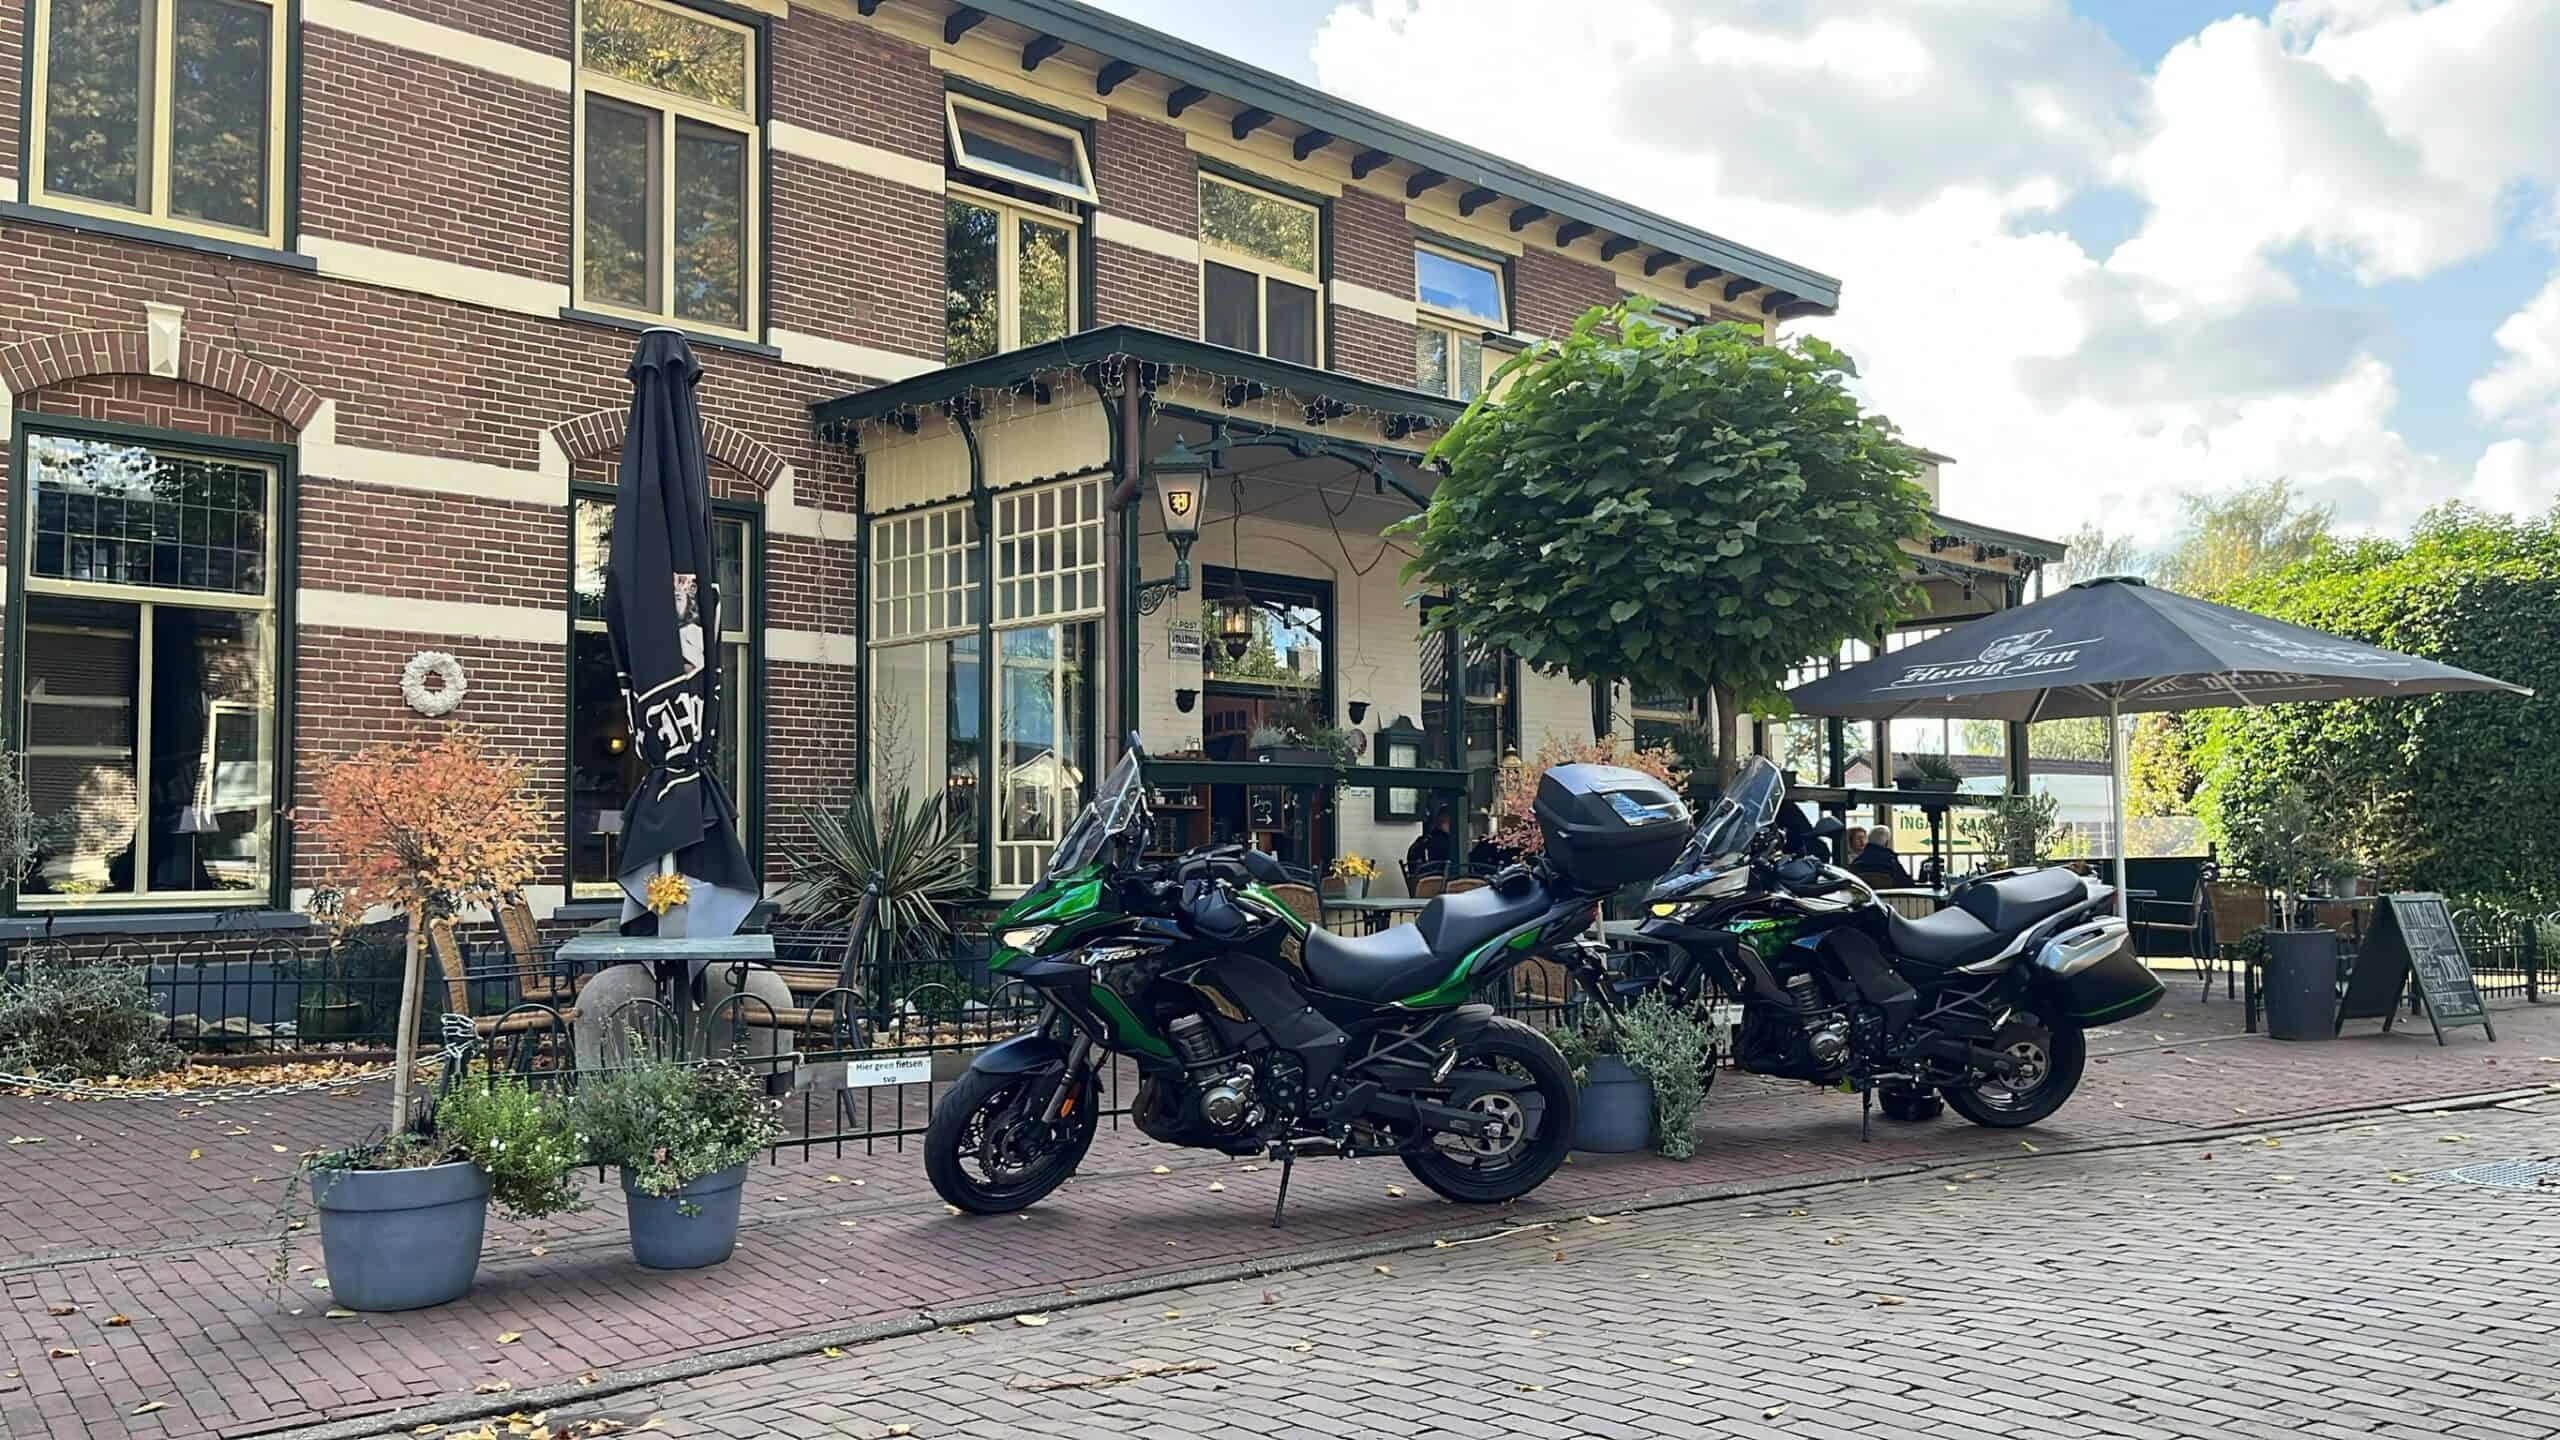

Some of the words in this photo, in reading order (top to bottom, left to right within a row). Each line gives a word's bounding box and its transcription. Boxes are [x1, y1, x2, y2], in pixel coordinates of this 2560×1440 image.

[856, 1063, 872, 1072] Hier
[875, 1063, 894, 1072] geen
[896, 1060, 923, 1069] fietsen
[883, 1076, 897, 1084] svp
